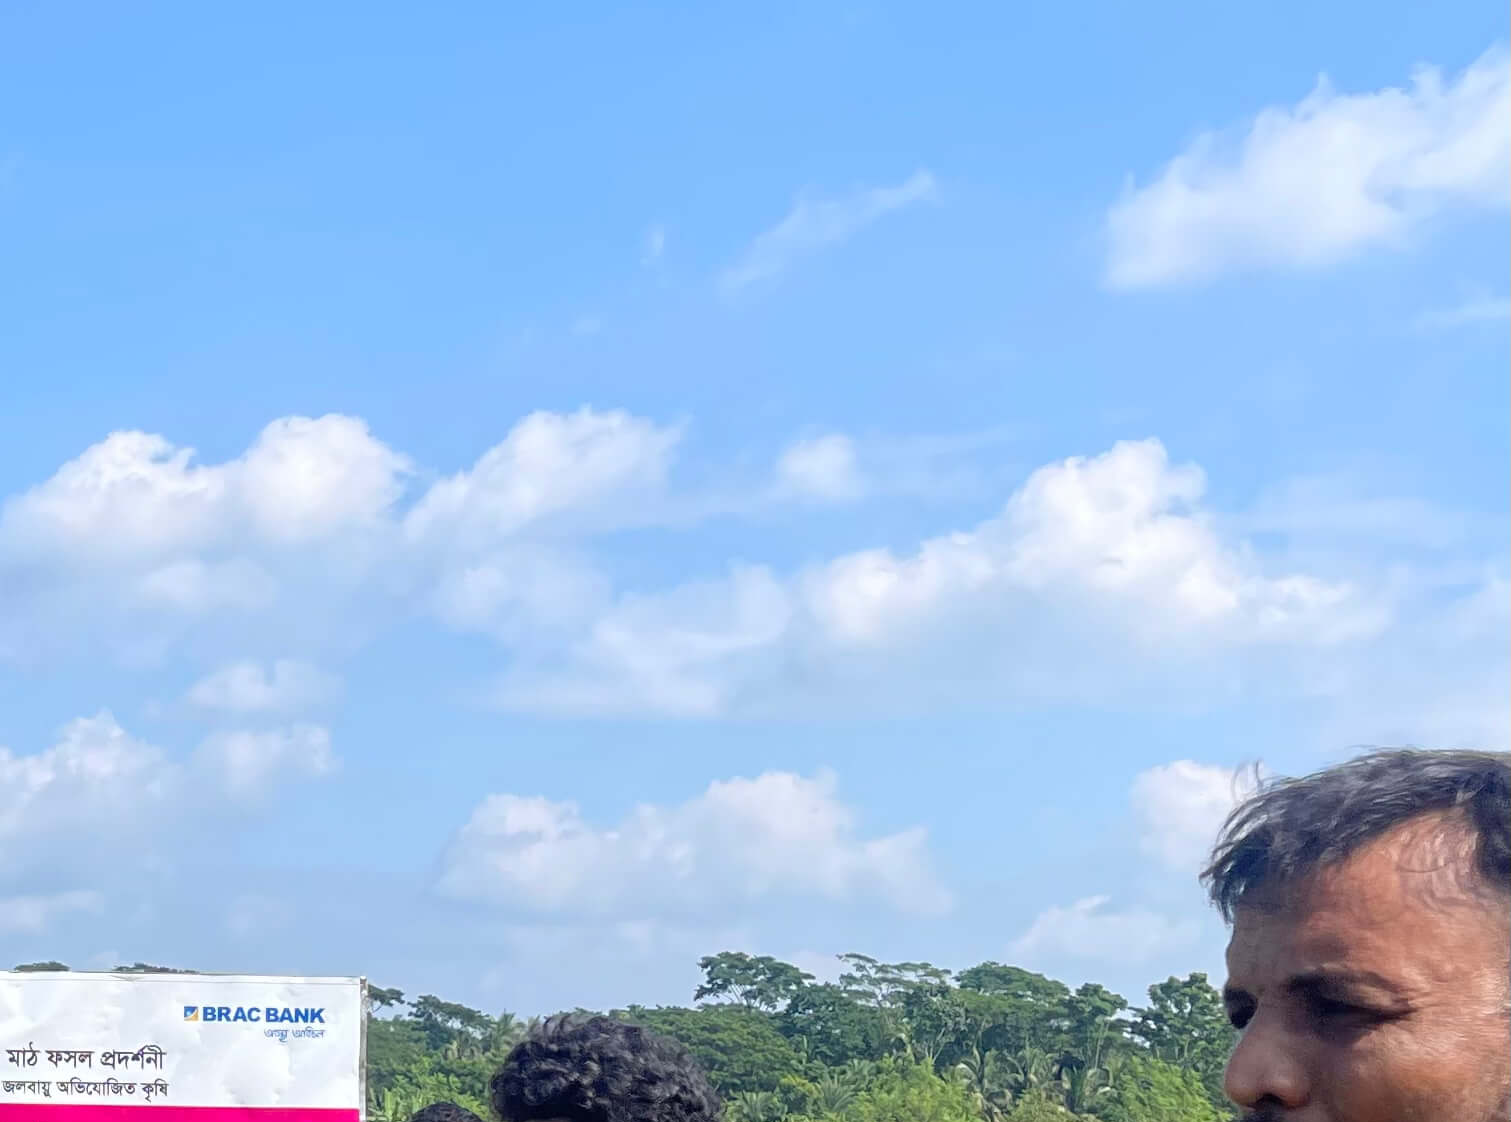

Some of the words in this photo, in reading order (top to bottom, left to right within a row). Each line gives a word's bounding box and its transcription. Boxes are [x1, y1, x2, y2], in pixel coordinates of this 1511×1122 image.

[203, 1006, 260, 1022] BRAC
[266, 1007, 325, 1023] BANK
[6, 1042, 39, 1068] মাঠ
[45, 1049, 92, 1069] ফসল
[100, 1044, 166, 1070] প্রদর্শনী
[2, 1079, 51, 1097] জলবায়ু
[56, 1078, 136, 1096] অভিযোজিত
[142, 1079, 169, 1102] কৃষি
